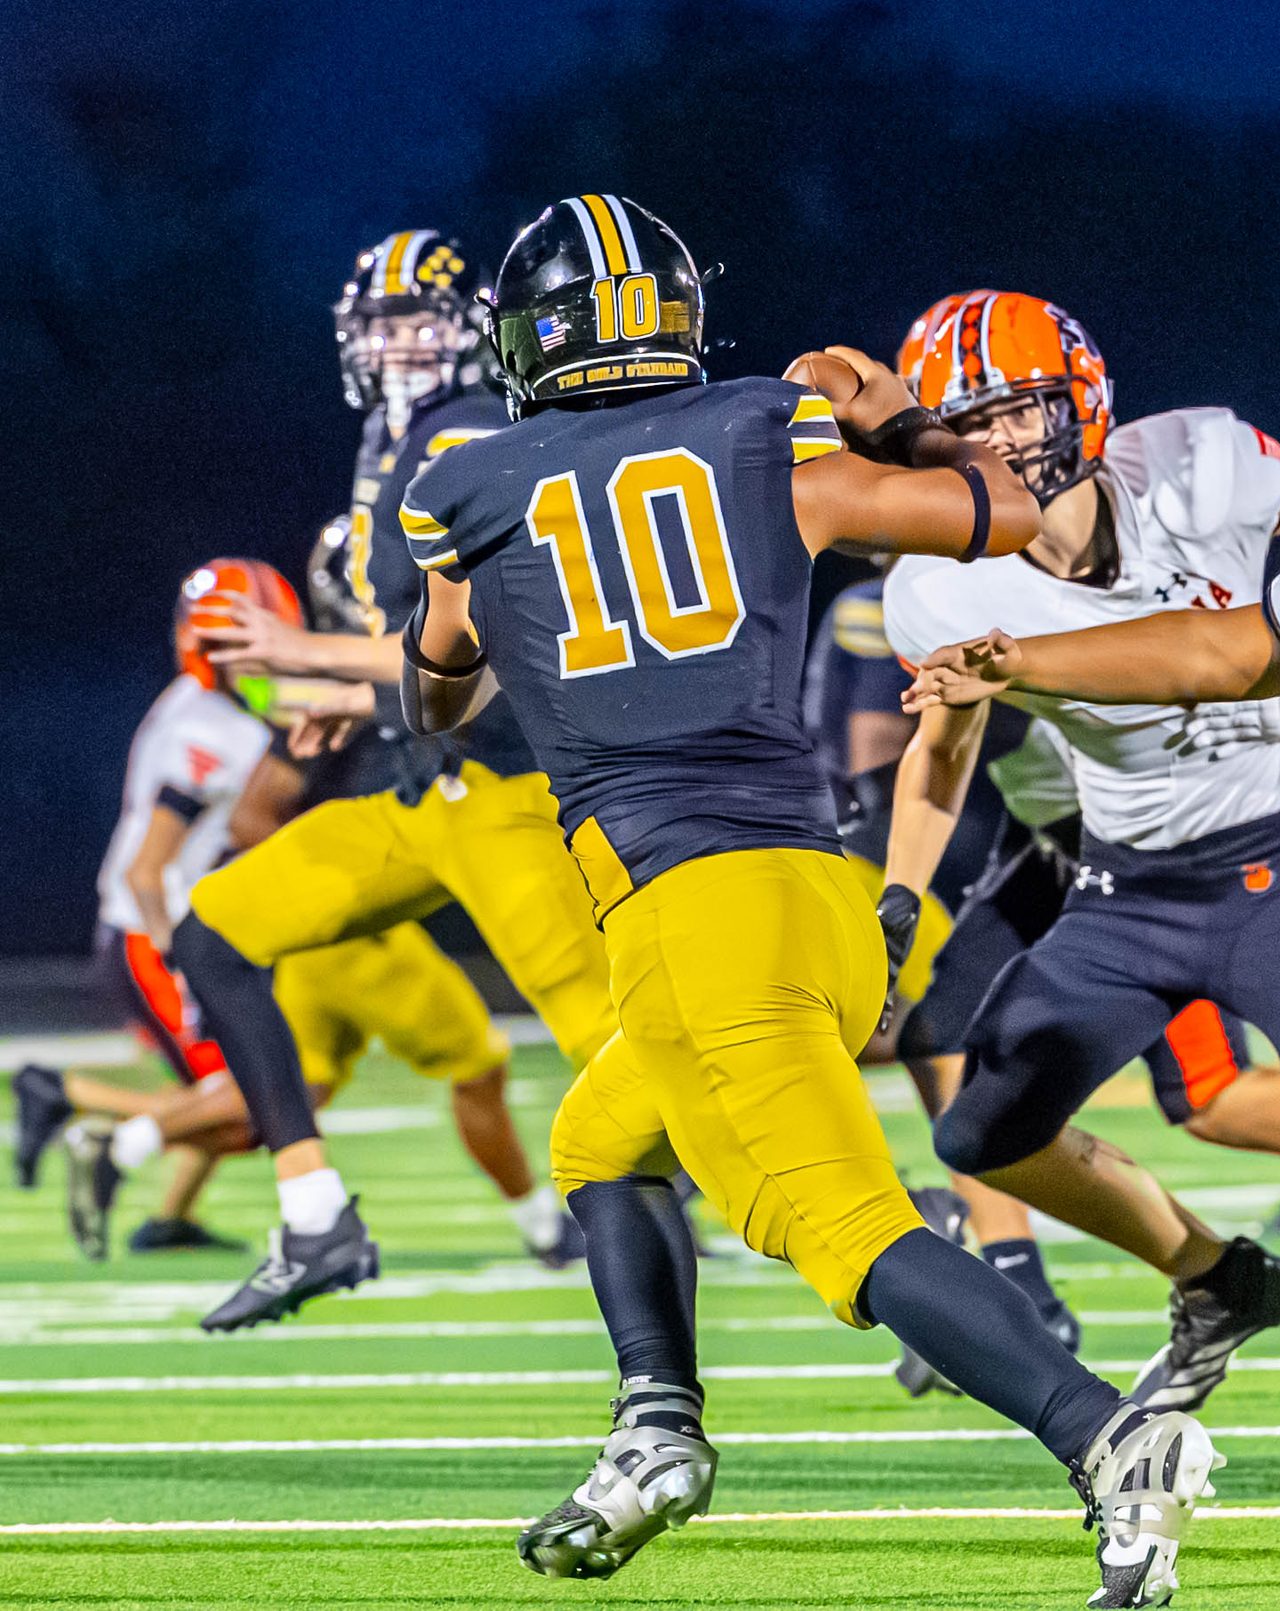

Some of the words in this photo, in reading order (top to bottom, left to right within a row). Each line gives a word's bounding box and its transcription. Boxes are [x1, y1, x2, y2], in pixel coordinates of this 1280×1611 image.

[590, 273, 661, 343] 10
[557, 371, 584, 390] THE
[586, 366, 623, 383] GOLD
[525, 446, 746, 679] 10
